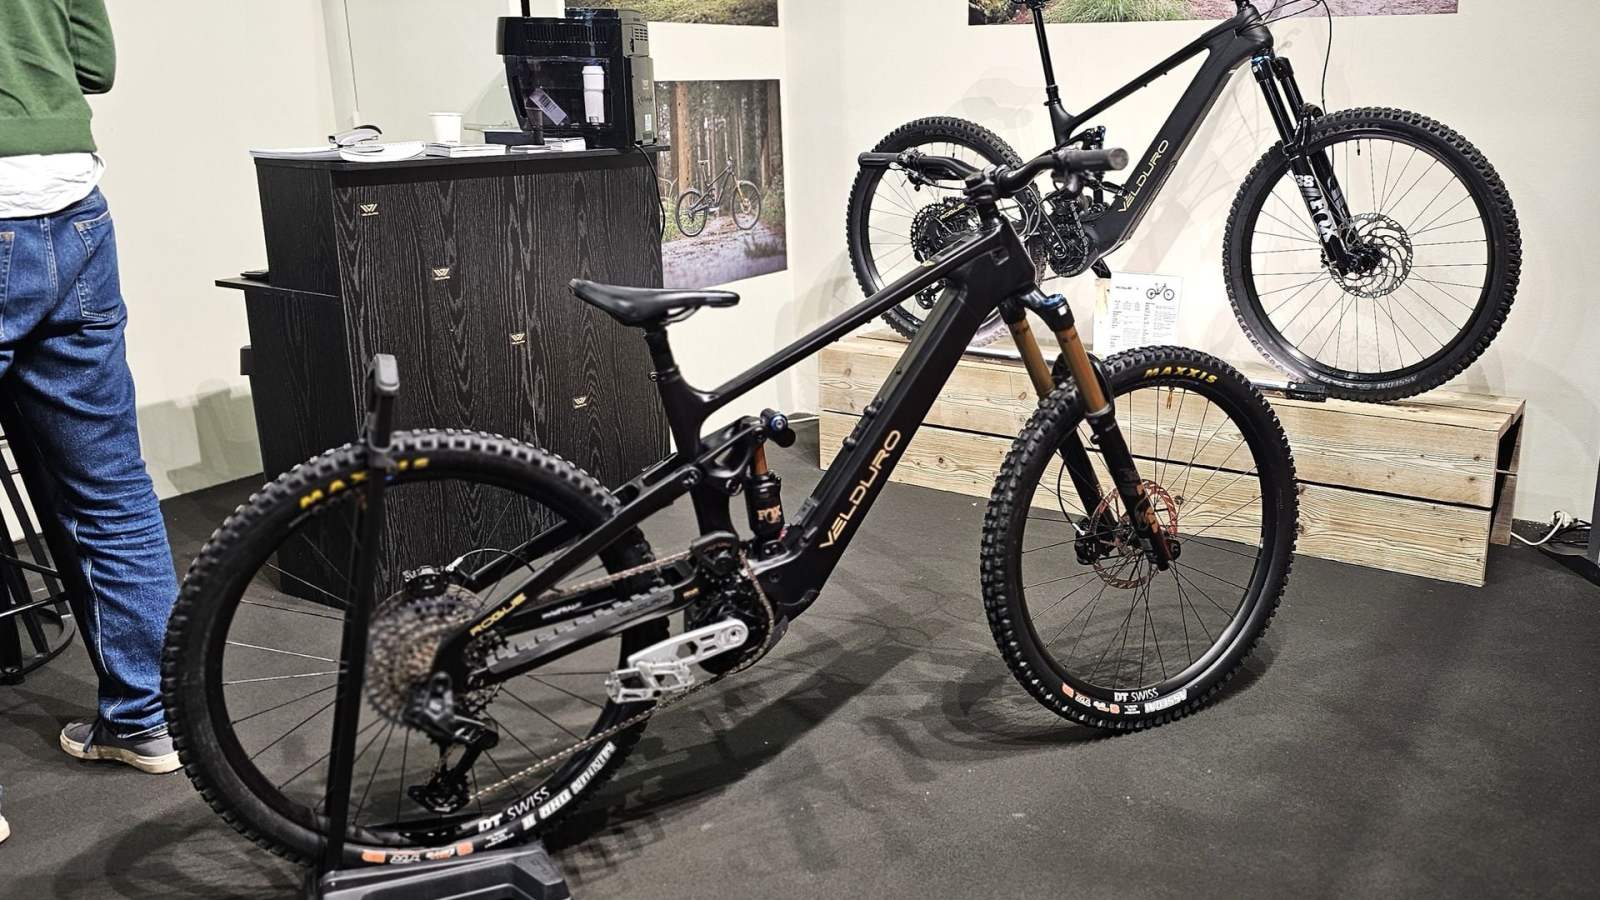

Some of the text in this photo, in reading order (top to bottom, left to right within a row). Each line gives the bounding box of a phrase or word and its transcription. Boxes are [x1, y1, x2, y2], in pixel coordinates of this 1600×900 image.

[1118, 140, 1169, 212] VELDURO
[1310, 199, 1340, 243] FOX
[1143, 366, 1218, 383] MAXXIS
[819, 430, 901, 548] VELDURO
[756, 504, 782, 524] FOX
[470, 592, 526, 637] ROGUE
[1113, 687, 1159, 702] DT SWISS
[478, 785, 551, 833] DT SWISS
